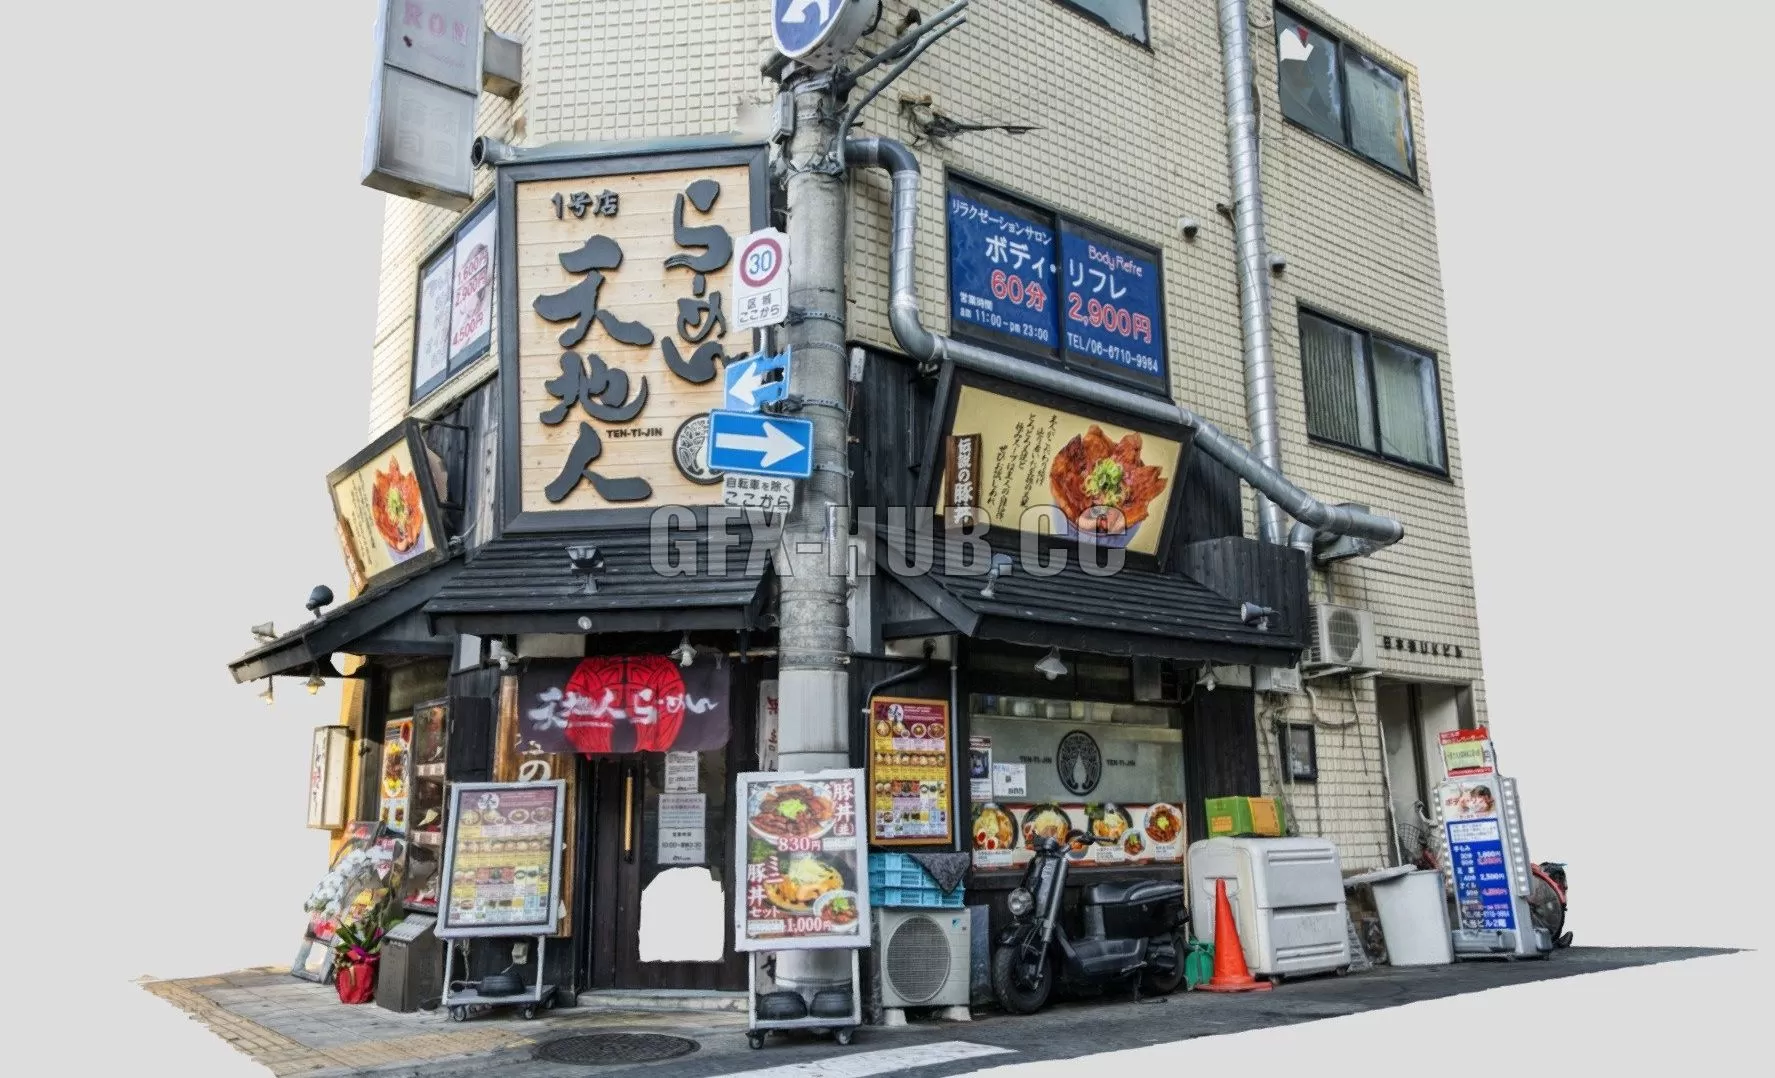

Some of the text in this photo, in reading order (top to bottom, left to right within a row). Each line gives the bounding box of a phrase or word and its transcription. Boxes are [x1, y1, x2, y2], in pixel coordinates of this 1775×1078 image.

[551, 189, 619, 221] 1号店
[951, 198, 1052, 246] リラクゼーションサロン
[748, 248, 773, 275] 30
[1087, 244, 1115, 271] Body
[990, 268, 1047, 312] 60分
[738, 304, 780, 324] ここから
[1067, 291, 1152, 344] 2,900円
[533, 234, 654, 503] 天地人
[606, 427, 663, 439] TEN-TI-JIN
[726, 477, 791, 492] 自転車を除く
[724, 491, 792, 511] ここから
[777, 836, 821, 852] 830円
[749, 906, 781, 919] セット
